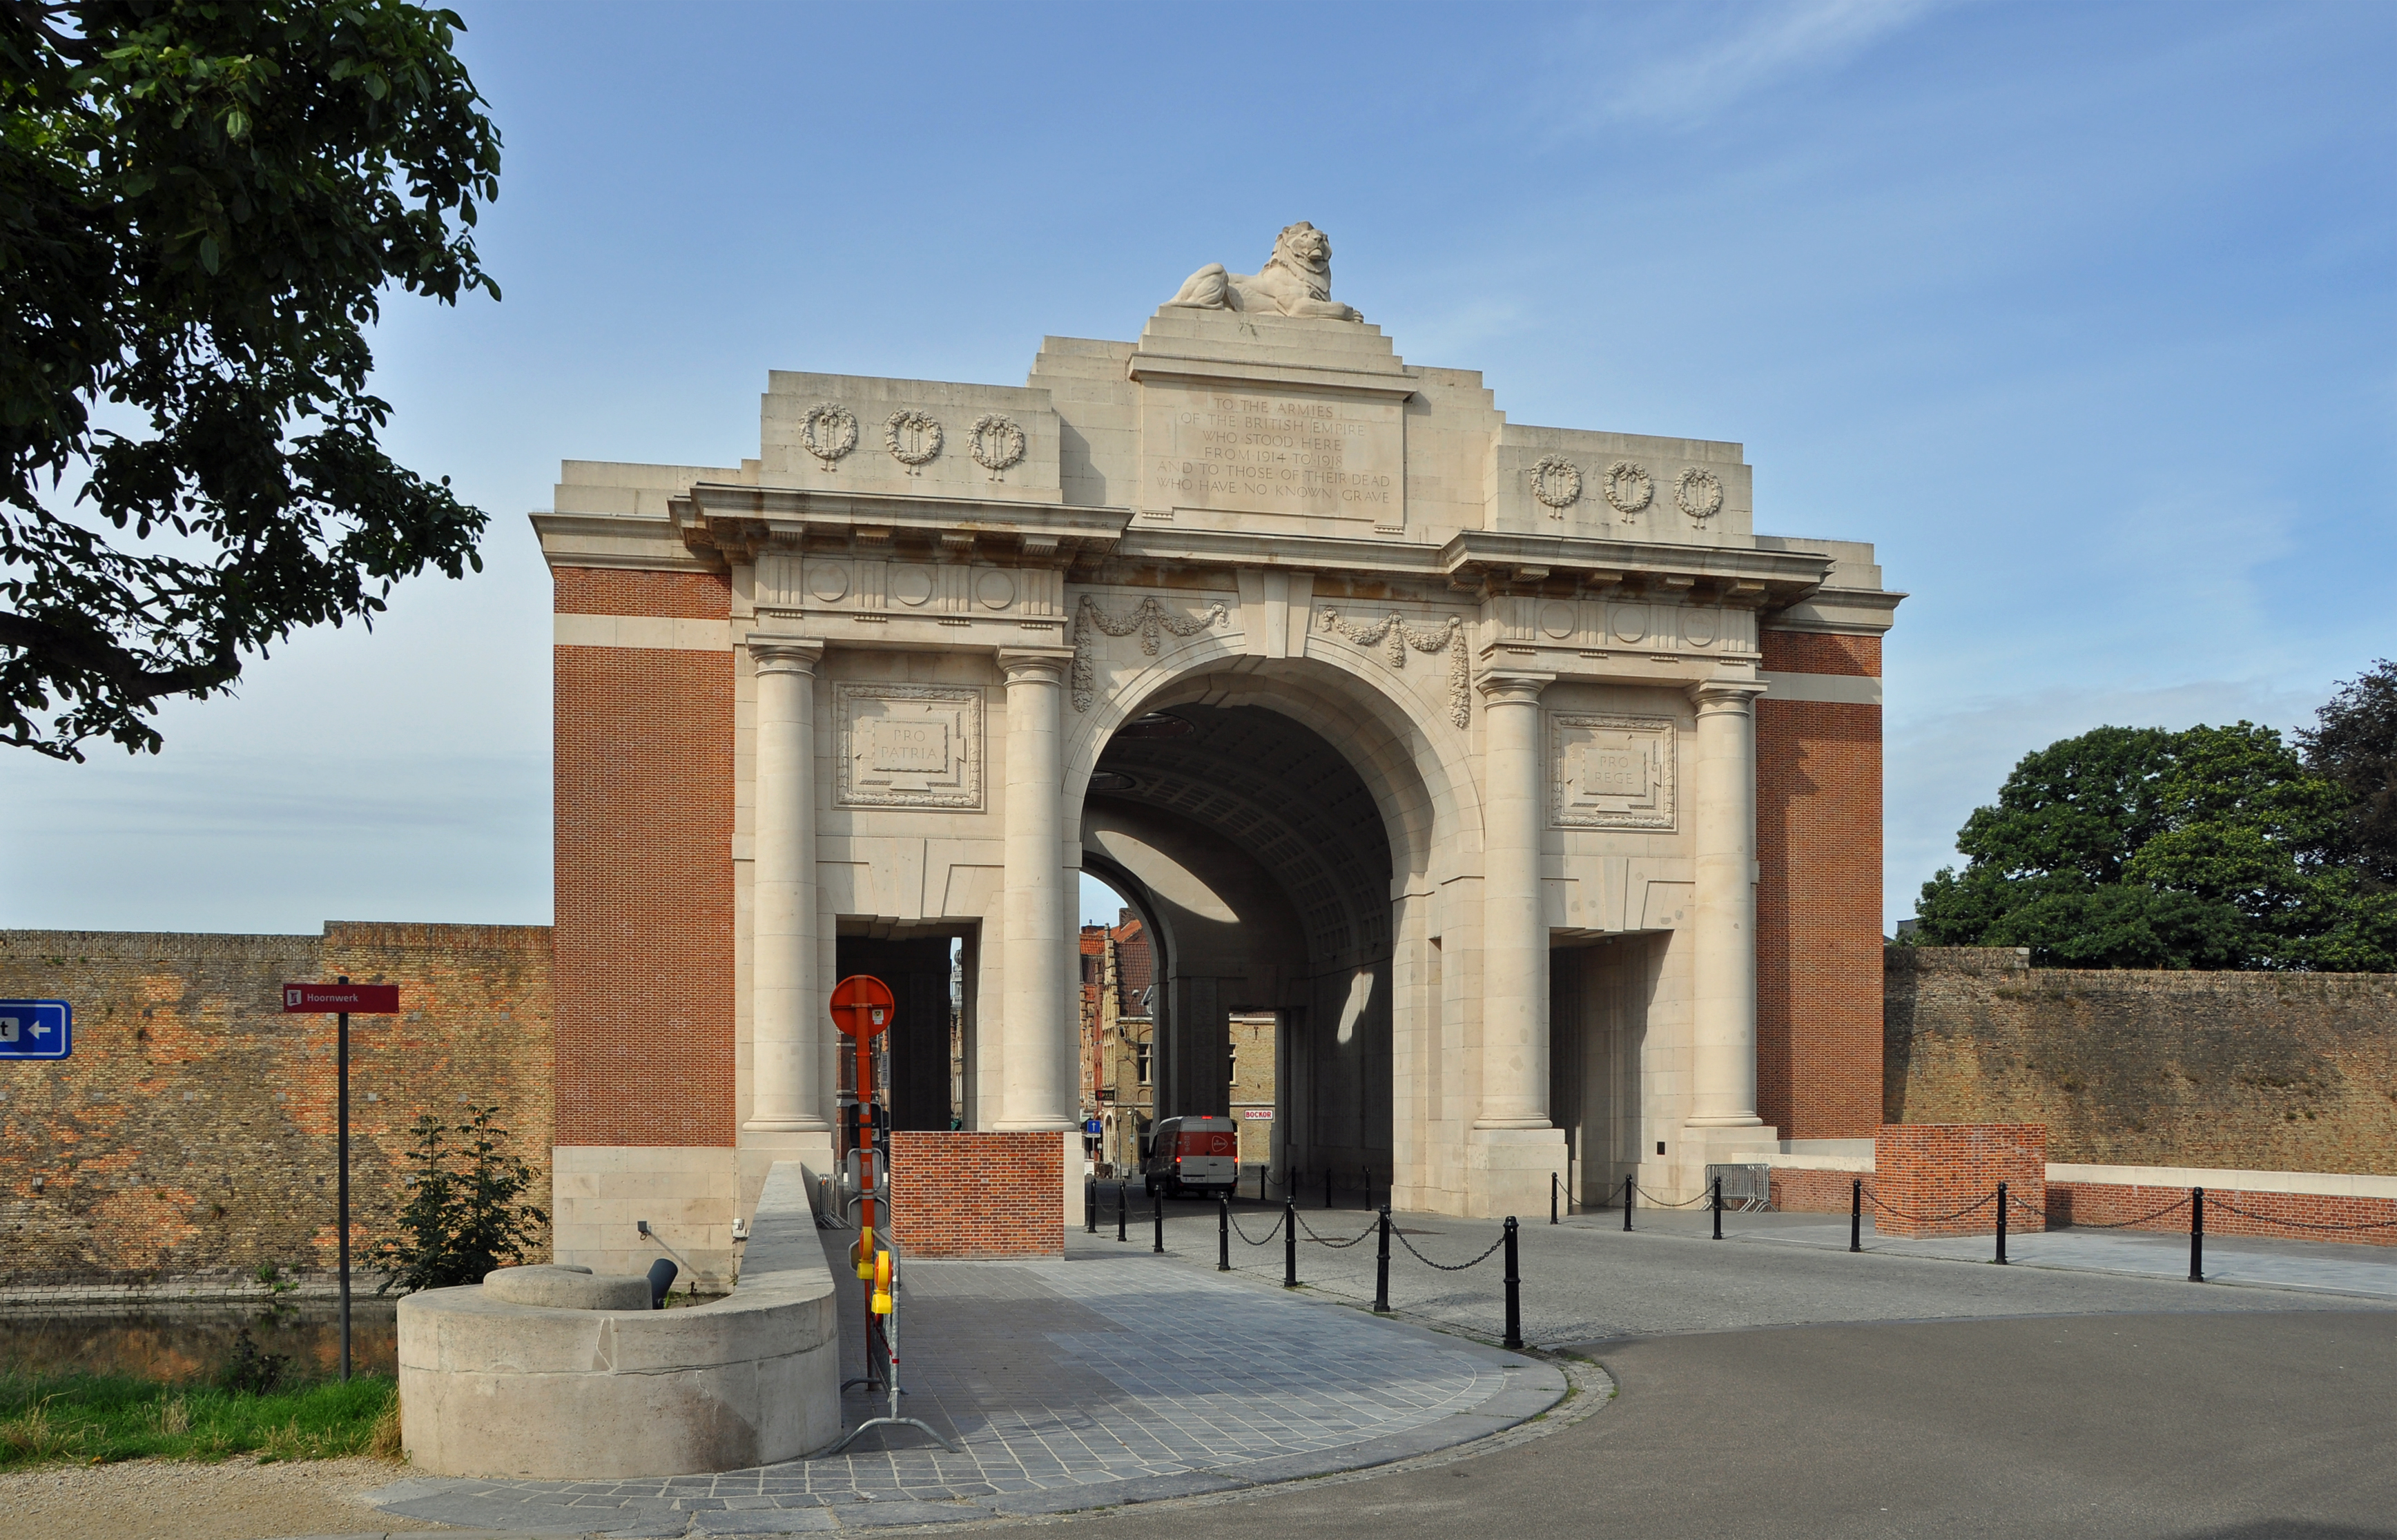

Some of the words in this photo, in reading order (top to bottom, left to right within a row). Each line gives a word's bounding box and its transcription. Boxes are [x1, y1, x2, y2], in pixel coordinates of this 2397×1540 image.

[1214, 398, 1234, 411] TO
[1241, 400, 1269, 413] THE
[1277, 402, 1333, 418] ARMIES
[1181, 412, 1200, 424] OF
[1207, 414, 1236, 427] THE
[1245, 417, 1303, 432] BRITISH
[1312, 422, 1365, 436] EMPIRE
[1203, 431, 1237, 444] WHO
[1245, 434, 1294, 447] STOOD
[1301, 438, 1341, 451] HERE
[1205, 447, 1250, 460] FROM
[1256, 451, 1285, 462] 1914
[1292, 453, 1311, 465] TO
[1317, 455, 1343, 467] 1918
[1158, 461, 1193, 474] AND
[1199, 462, 1219, 476] TO
[1225, 465, 1273, 479] THOSE
[1281, 469, 1299, 480] OF
[1304, 470, 1346, 484] THEIR
[1352, 474, 1390, 487] DEAD
[1157, 477, 1192, 490] WHO
[1199, 480, 1237, 494] HAVE
[1245, 483, 1268, 495] NO
[1276, 485, 1332, 499] KNOWN
[1342, 489, 1390, 503] GRAVE
[894, 730, 926, 742] PRO
[881, 746, 938, 759] PATRIA
[1600, 756, 1629, 768] PRO
[1595, 772, 1633, 784] REGE
[307, 993, 358, 1002] Hoornwerk
